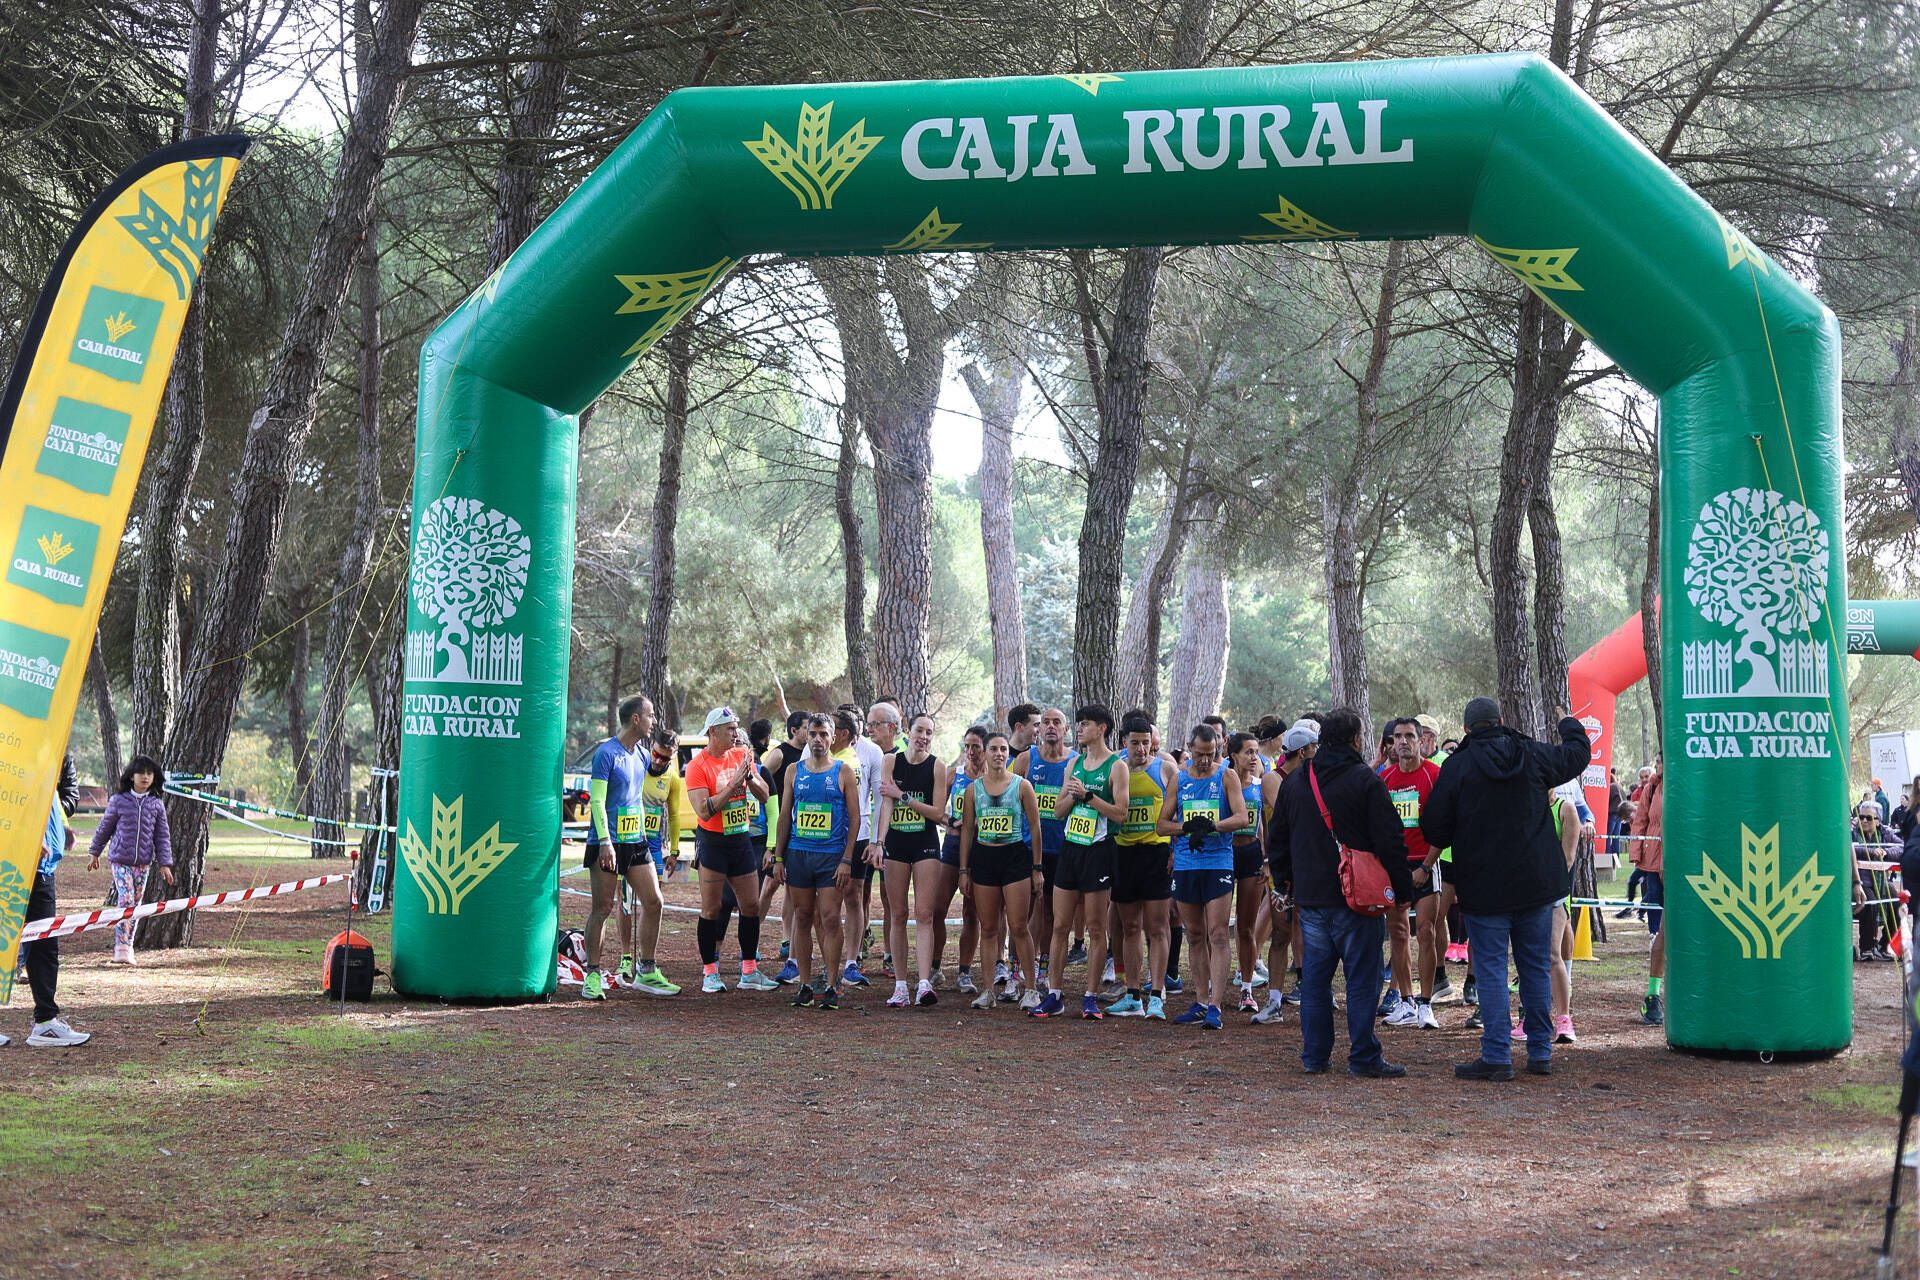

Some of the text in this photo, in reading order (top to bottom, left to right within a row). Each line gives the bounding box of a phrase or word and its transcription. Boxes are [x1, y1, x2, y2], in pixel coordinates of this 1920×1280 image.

[901, 100, 1414, 183] CAJA RURAL
[78, 339, 143, 365] CAJA RURAL
[45, 436, 118, 467] CAJA RURAL
[13, 558, 84, 588] CAJA RURAL
[1847, 608, 1875, 624] ON
[18, 666, 55, 690] RURAL
[405, 694, 521, 717] FUNDACION
[404, 715, 520, 739] CAJA RURAL
[1685, 711, 1831, 734] FUNDACION
[1685, 735, 1831, 760] CAJA RURAL
[725, 808, 747, 825] 1655
[799, 813, 826, 828] 1722
[981, 817, 1009, 832] 0762
[1070, 817, 1090, 834] 1768
